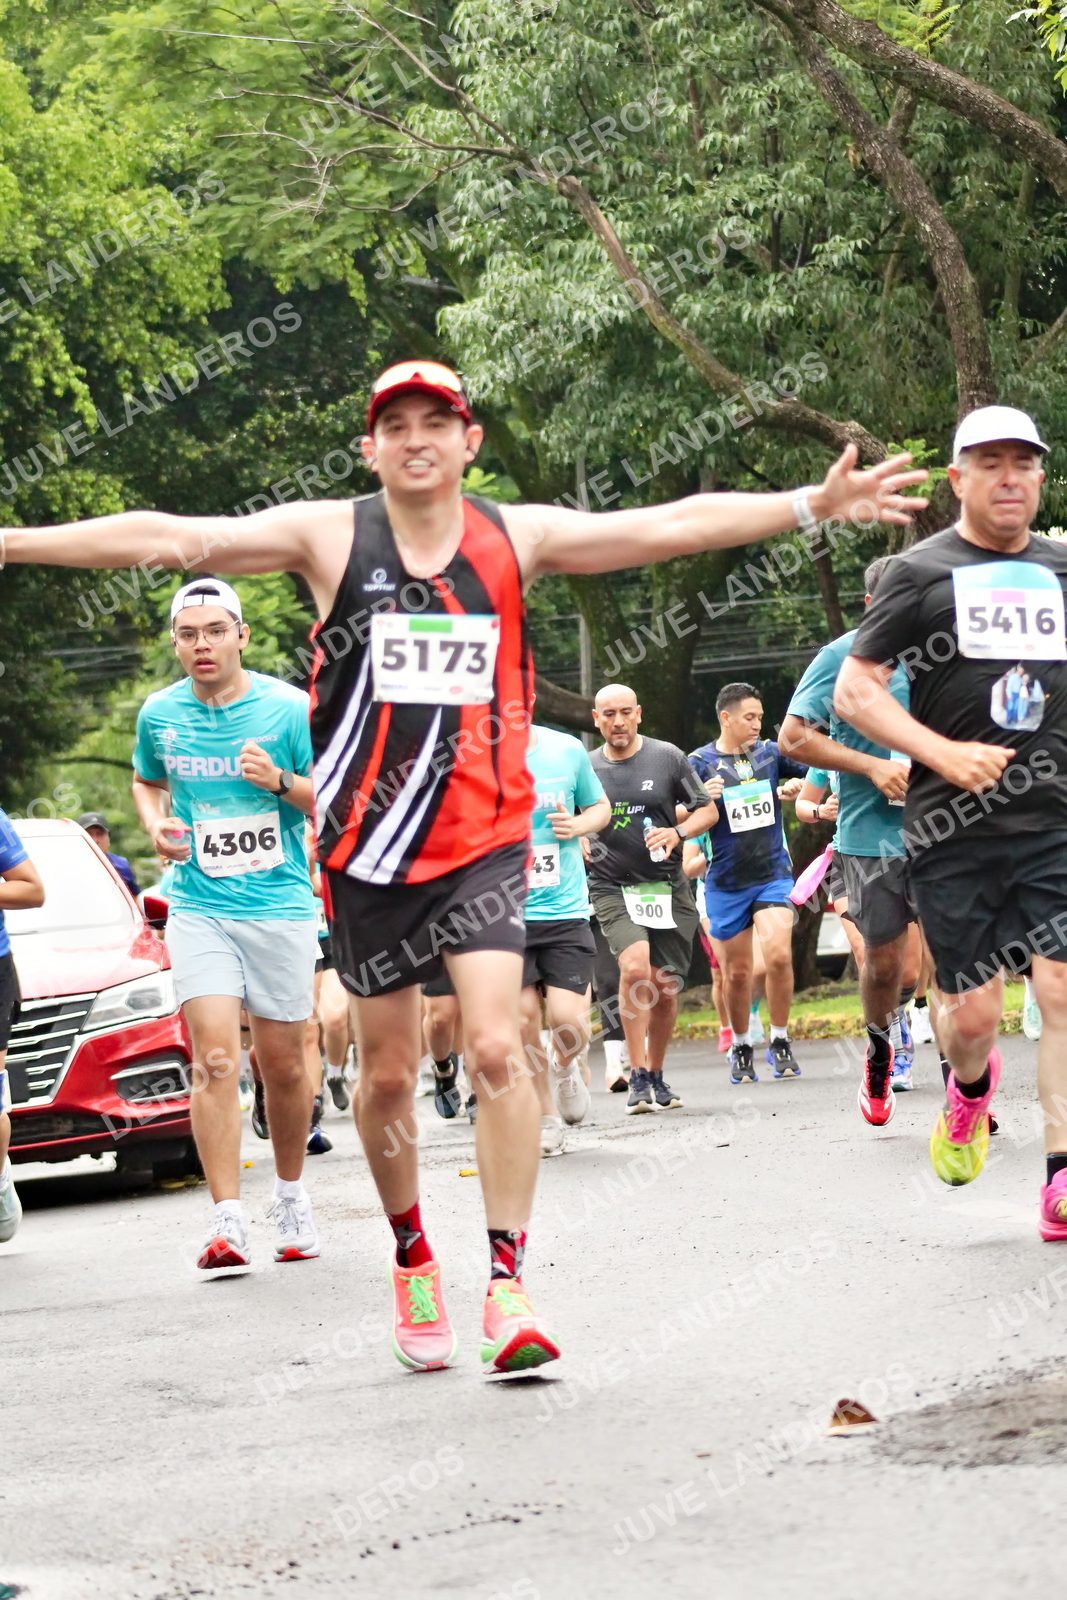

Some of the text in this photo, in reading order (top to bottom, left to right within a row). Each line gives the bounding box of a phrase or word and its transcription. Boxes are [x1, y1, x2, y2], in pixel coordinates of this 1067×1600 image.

[967, 606, 1056, 636] 5416
[380, 638, 488, 675] 5173
[627, 805, 646, 815] UP!
[731, 801, 772, 821] 4150
[202, 827, 277, 858] 4306
[635, 903, 664, 919] 900
